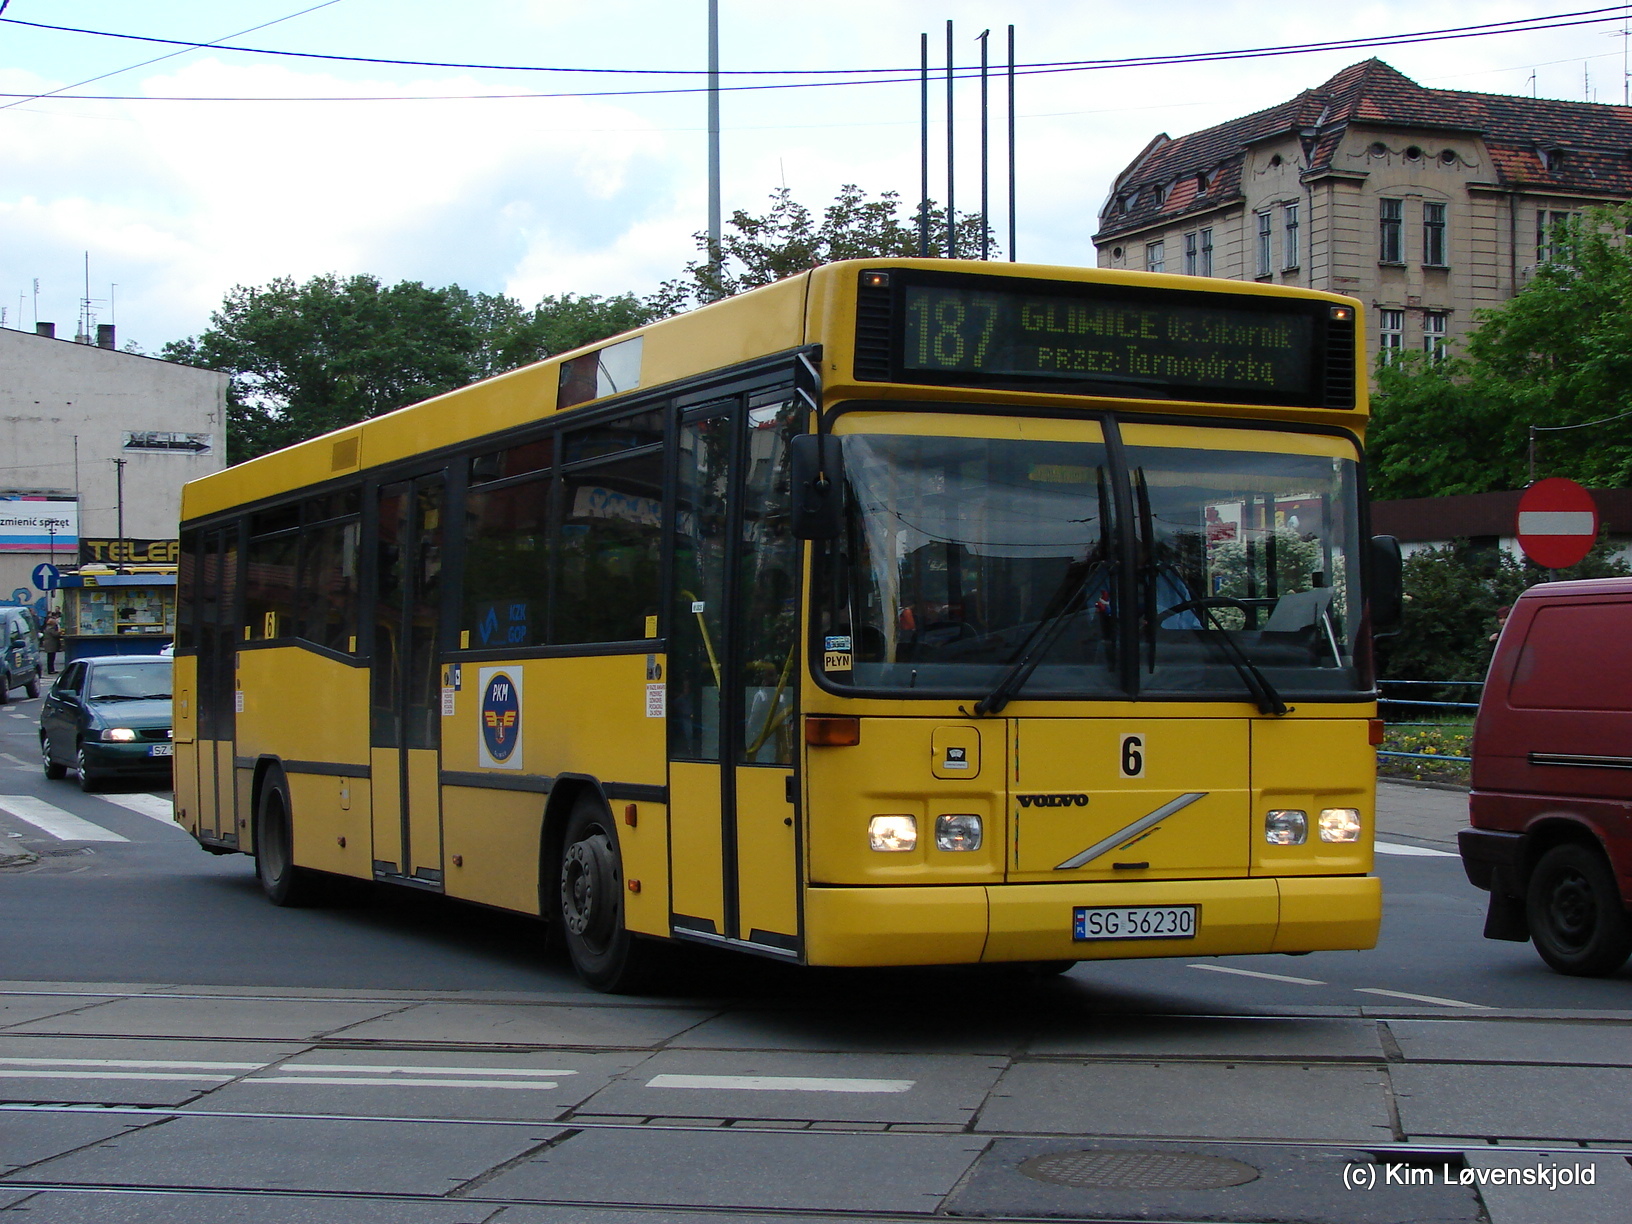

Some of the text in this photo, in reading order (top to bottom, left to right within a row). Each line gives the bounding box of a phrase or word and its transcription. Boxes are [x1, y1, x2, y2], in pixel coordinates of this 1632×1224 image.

[1021, 302, 1159, 340] GLIWICE
[909, 296, 998, 368] 187
[0, 517, 37, 526] zmienić
[509, 603, 527, 621] KZK
[267, 613, 273, 637] 6
[508, 625, 527, 643] GOP
[825, 655, 850, 667] PŁYN
[492, 683, 509, 702] PKM
[1122, 736, 1142, 776] 6
[1016, 794, 1089, 808] VOLVO
[1089, 910, 1191, 934] SG 56230
